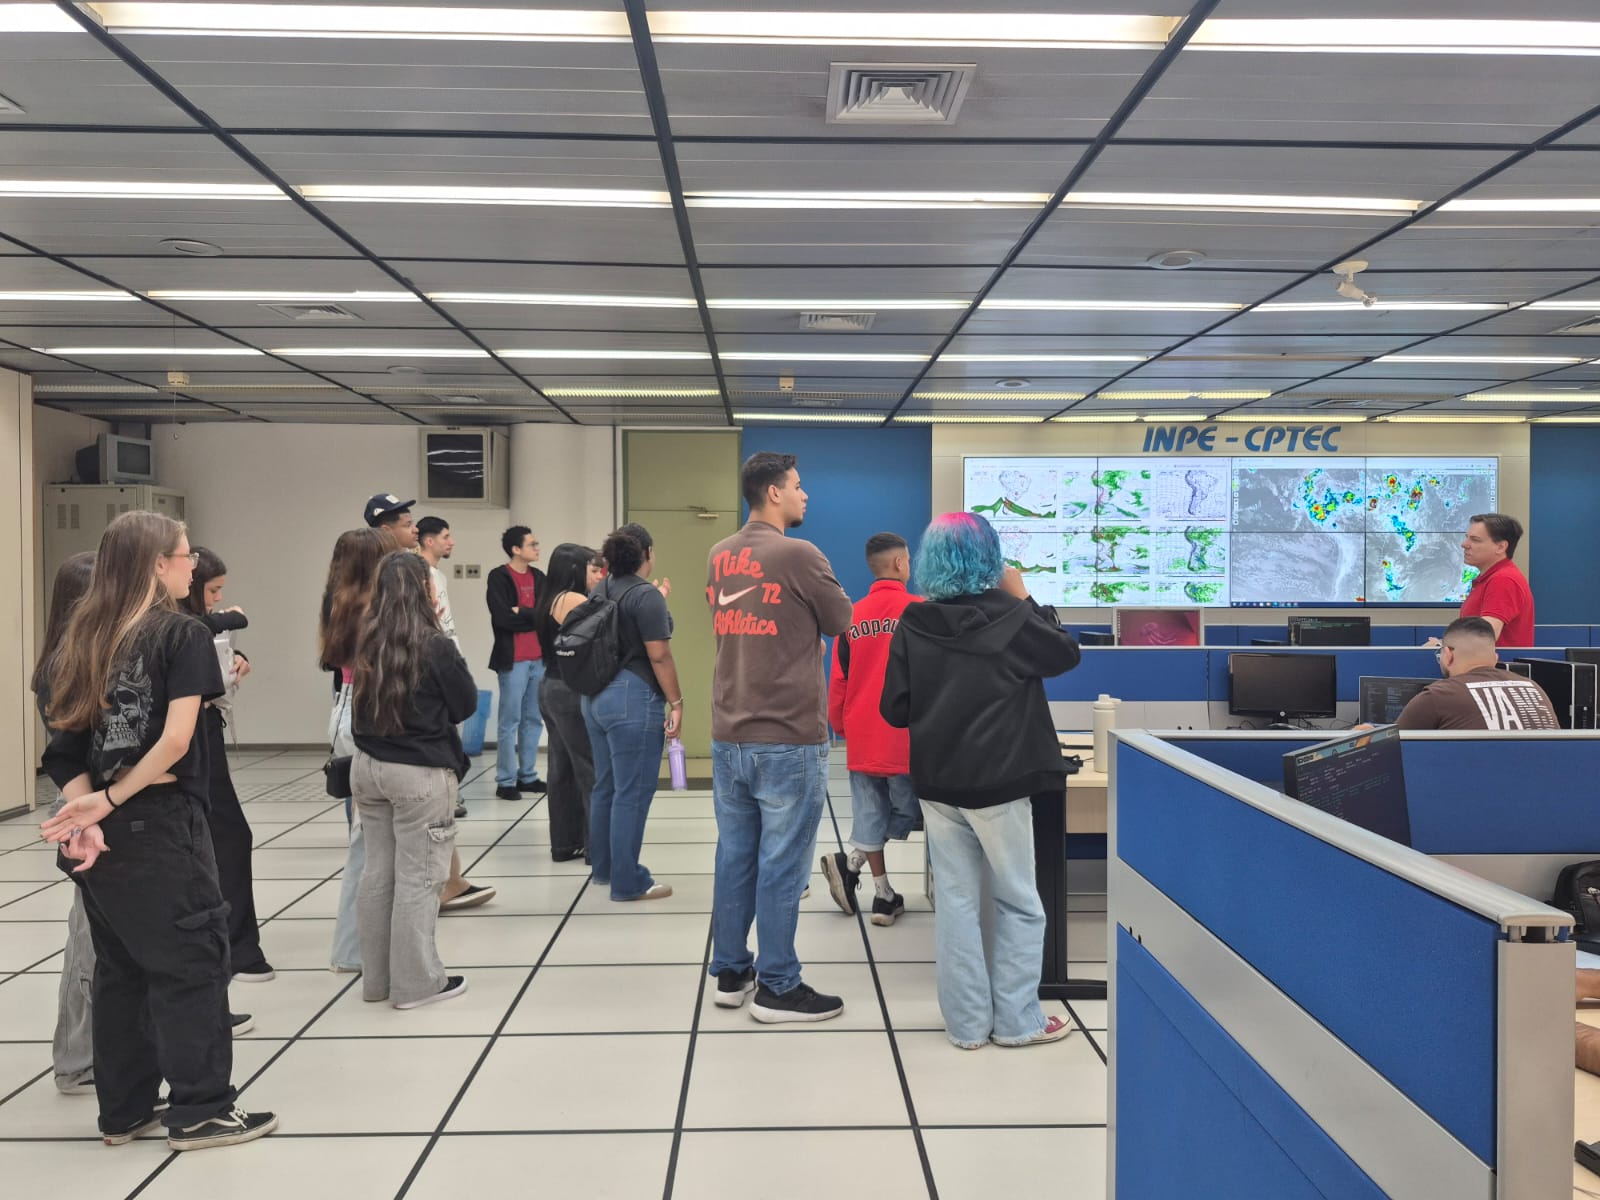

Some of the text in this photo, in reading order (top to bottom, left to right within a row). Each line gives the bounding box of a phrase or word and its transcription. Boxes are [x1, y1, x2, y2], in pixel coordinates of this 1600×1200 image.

[1142, 425, 1218, 452] INPE
[1244, 425, 1342, 452] CPTEC
[713, 546, 764, 583] Nike
[761, 583, 782, 604] 72
[713, 608, 778, 636] Athletics
